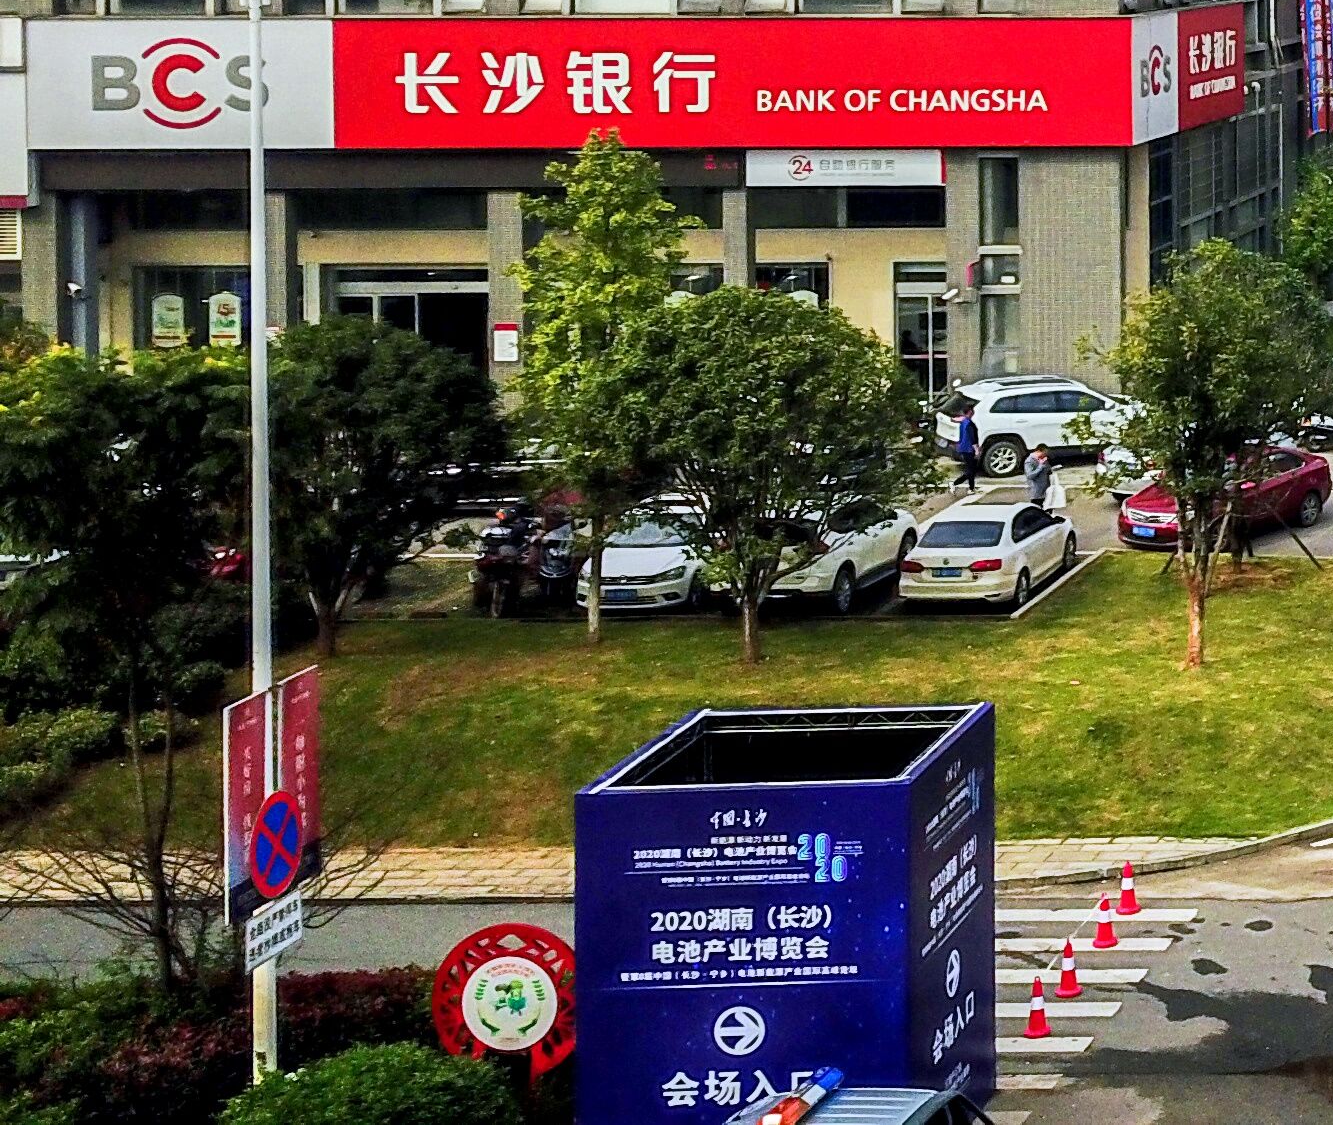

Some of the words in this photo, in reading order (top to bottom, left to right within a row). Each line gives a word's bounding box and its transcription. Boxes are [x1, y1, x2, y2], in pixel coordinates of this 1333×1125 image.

[1188, 29, 1237, 75] 长沙银行
[91, 40, 269, 125] BCS
[394, 50, 717, 115] 长沙银行
[1140, 53, 1172, 97] BCS
[756, 89, 838, 113] BANK
[845, 89, 883, 113] OF
[891, 89, 1048, 113] CHANGSHA
[791, 159, 814, 175] 24
[650, 904, 832, 933] 2020湖南（长沙）
[651, 935, 830, 964] 电池产业博览会
[932, 990, 976, 1066] 会场入口
